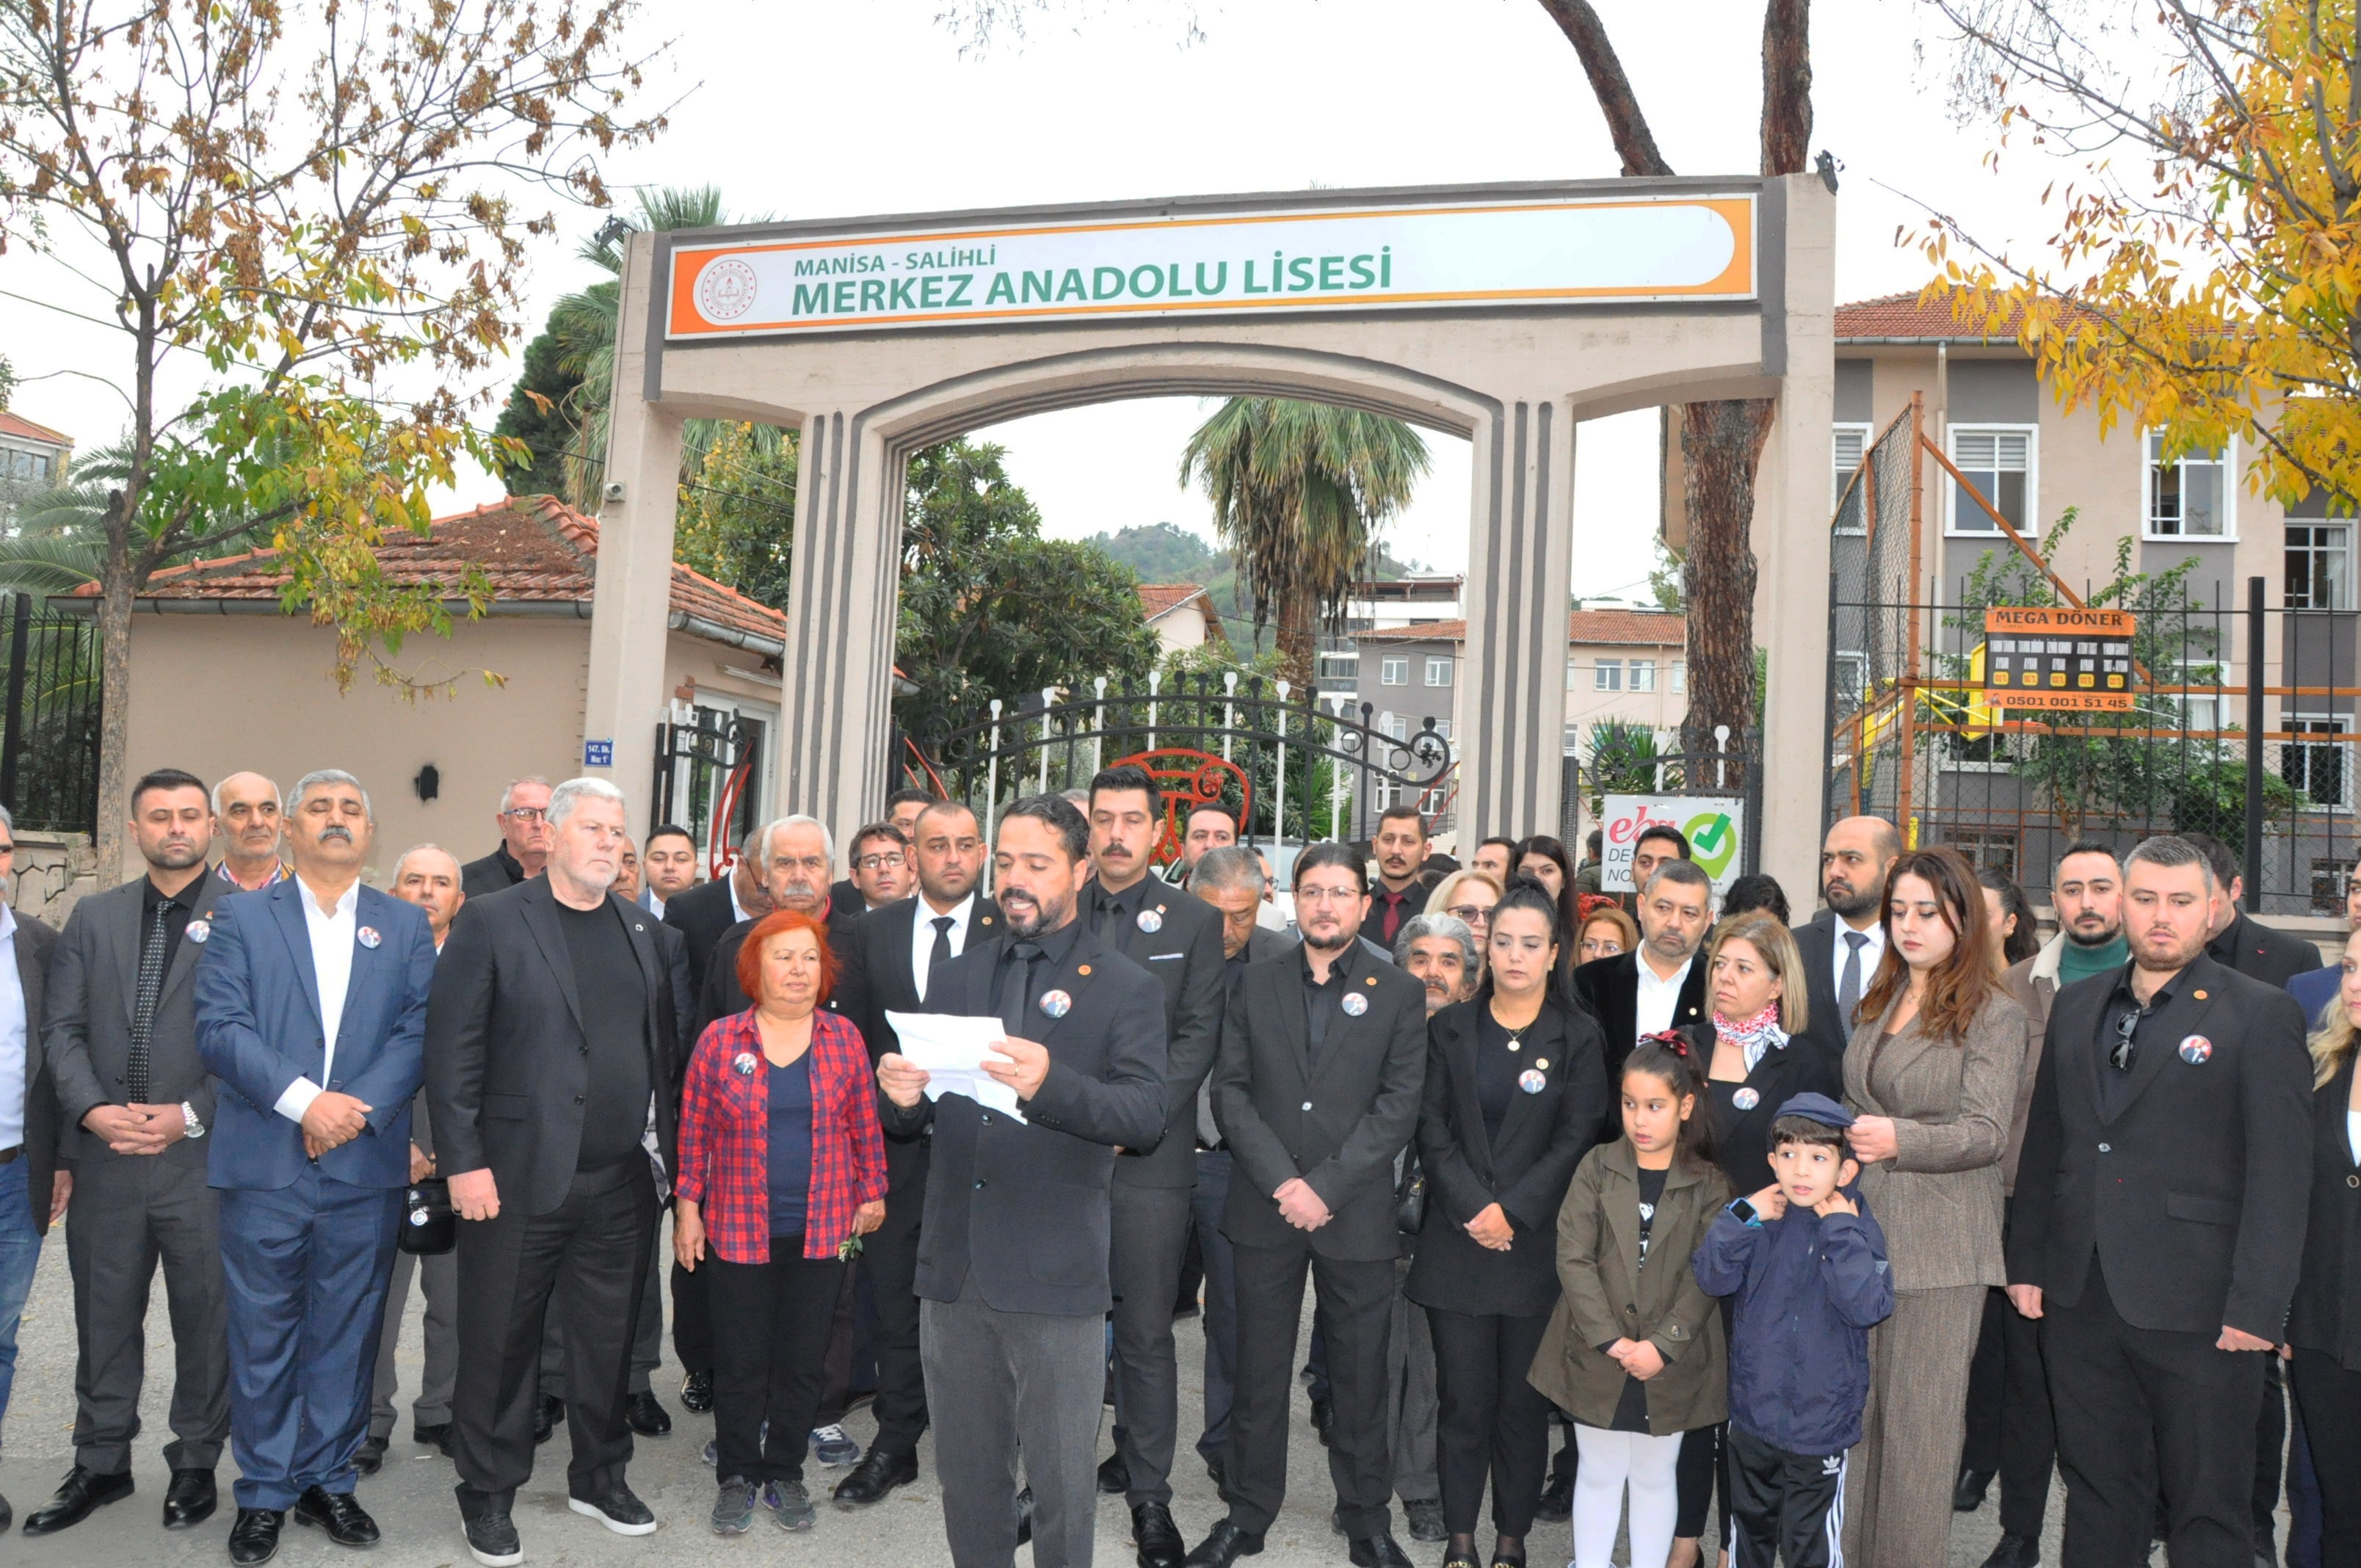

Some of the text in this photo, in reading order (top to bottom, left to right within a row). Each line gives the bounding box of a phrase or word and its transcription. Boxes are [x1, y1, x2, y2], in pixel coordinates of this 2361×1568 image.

[794, 253, 886, 277] MANİSA
[905, 244, 996, 269] SALİHLİ
[791, 274, 974, 316] MERKEZ
[985, 261, 1227, 305] ANADOLU
[1244, 245, 1391, 294] LİSESİ
[1995, 609, 2122, 625] MEGA DÖNER
[2006, 696, 2128, 708] 0501 001 51 45
[588, 744, 601, 753] 147.
[590, 755, 601, 763] No:
